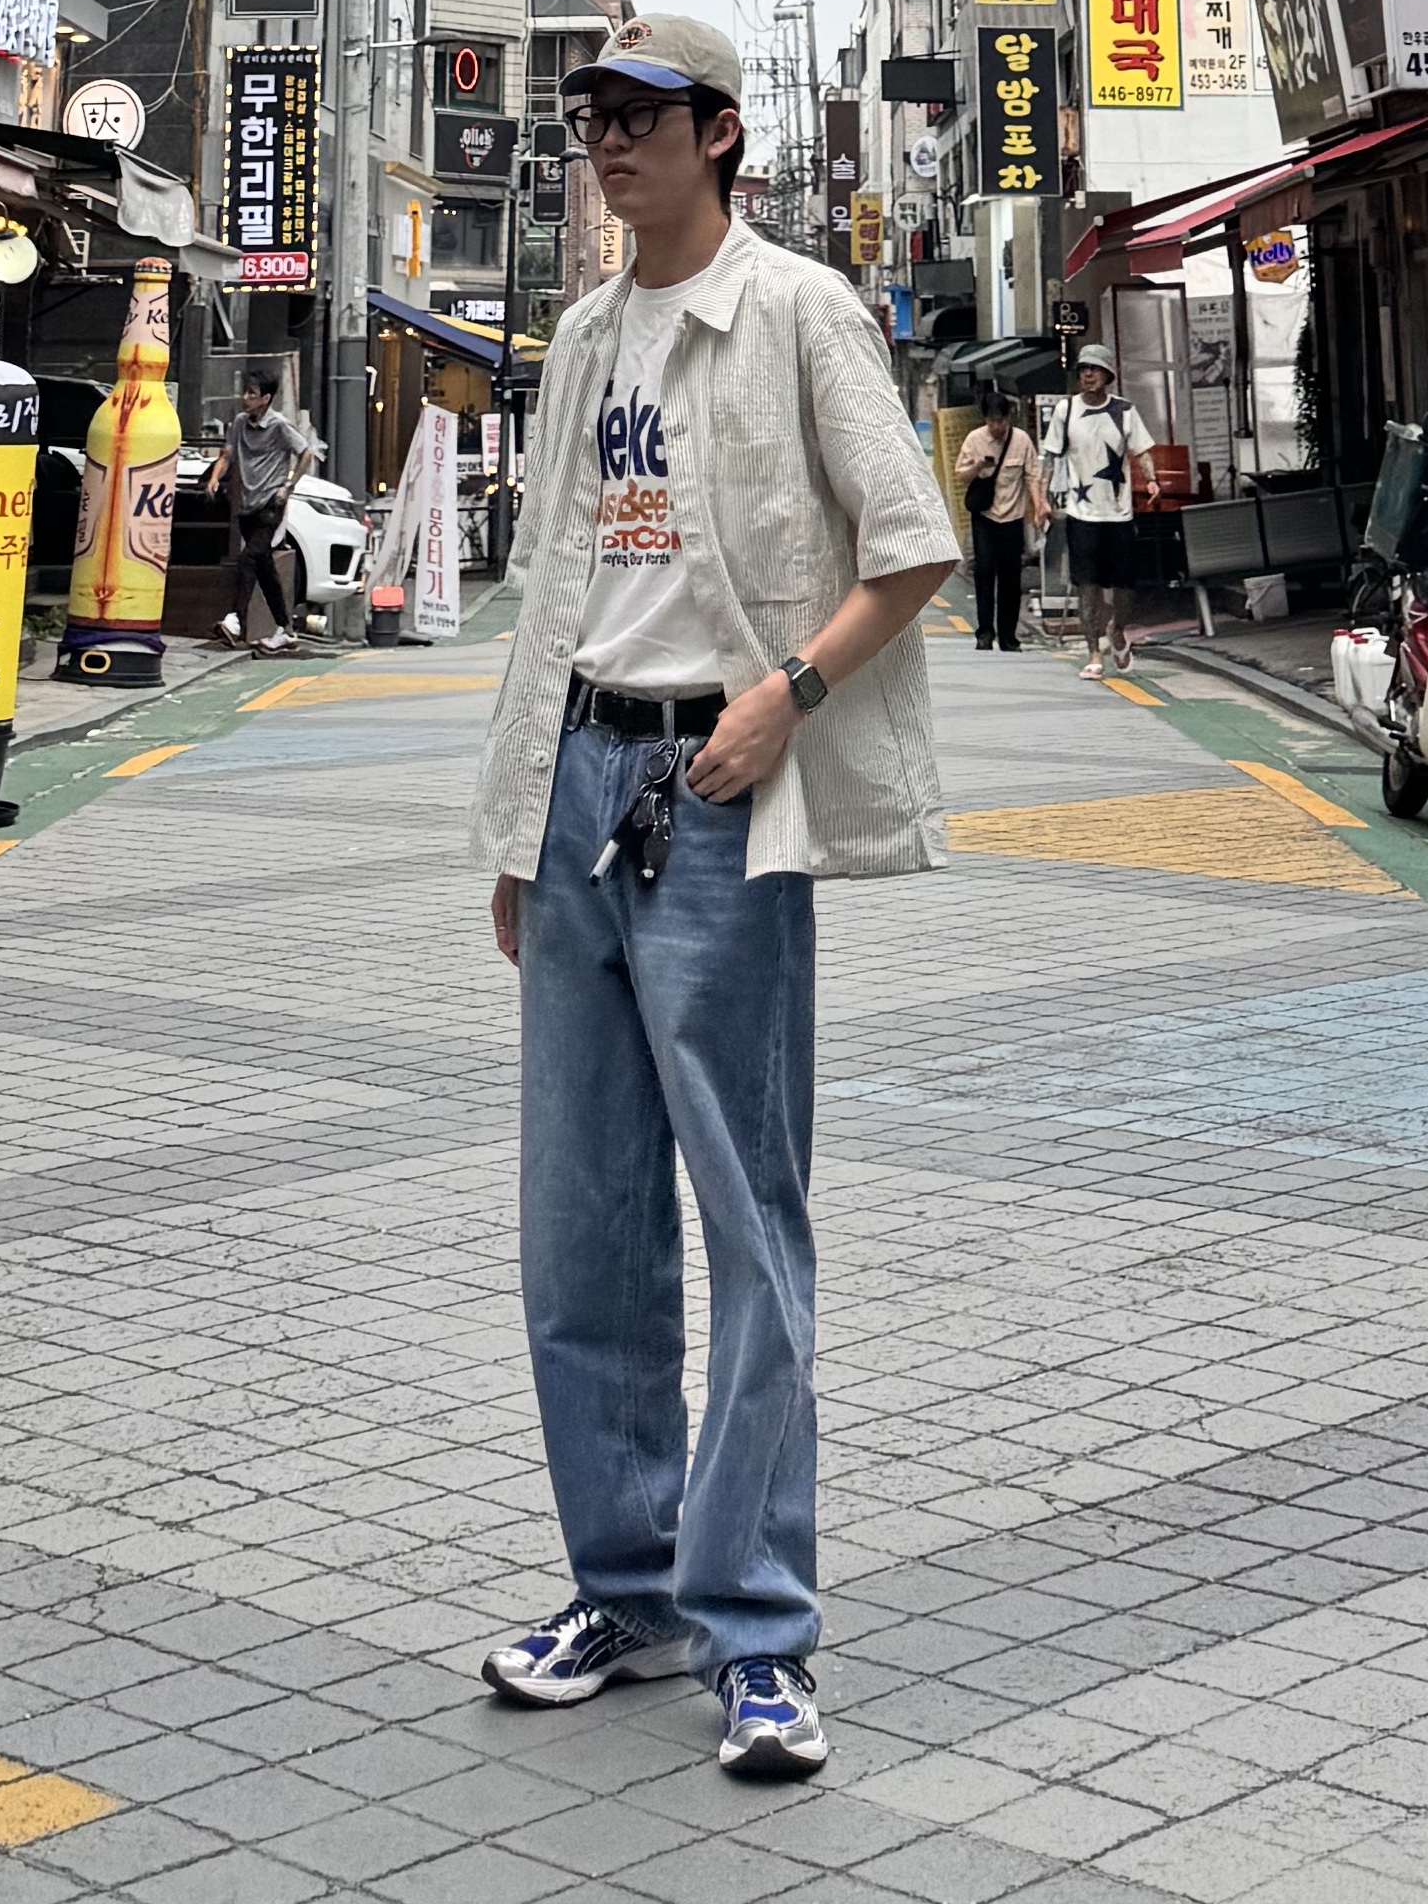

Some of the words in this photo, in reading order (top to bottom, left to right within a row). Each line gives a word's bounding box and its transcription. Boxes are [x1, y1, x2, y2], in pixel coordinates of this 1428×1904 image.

[1228, 55, 1247, 68] 2F
[1098, 87, 1173, 103] 446-8977
[1190, 75, 1247, 89] 453-3456
[995, 33, 1042, 190] 달밤포차
[238, 74, 278, 246] 무한리필
[602, 204, 616, 265] KUSHU
[1249, 240, 1296, 267] Kelly
